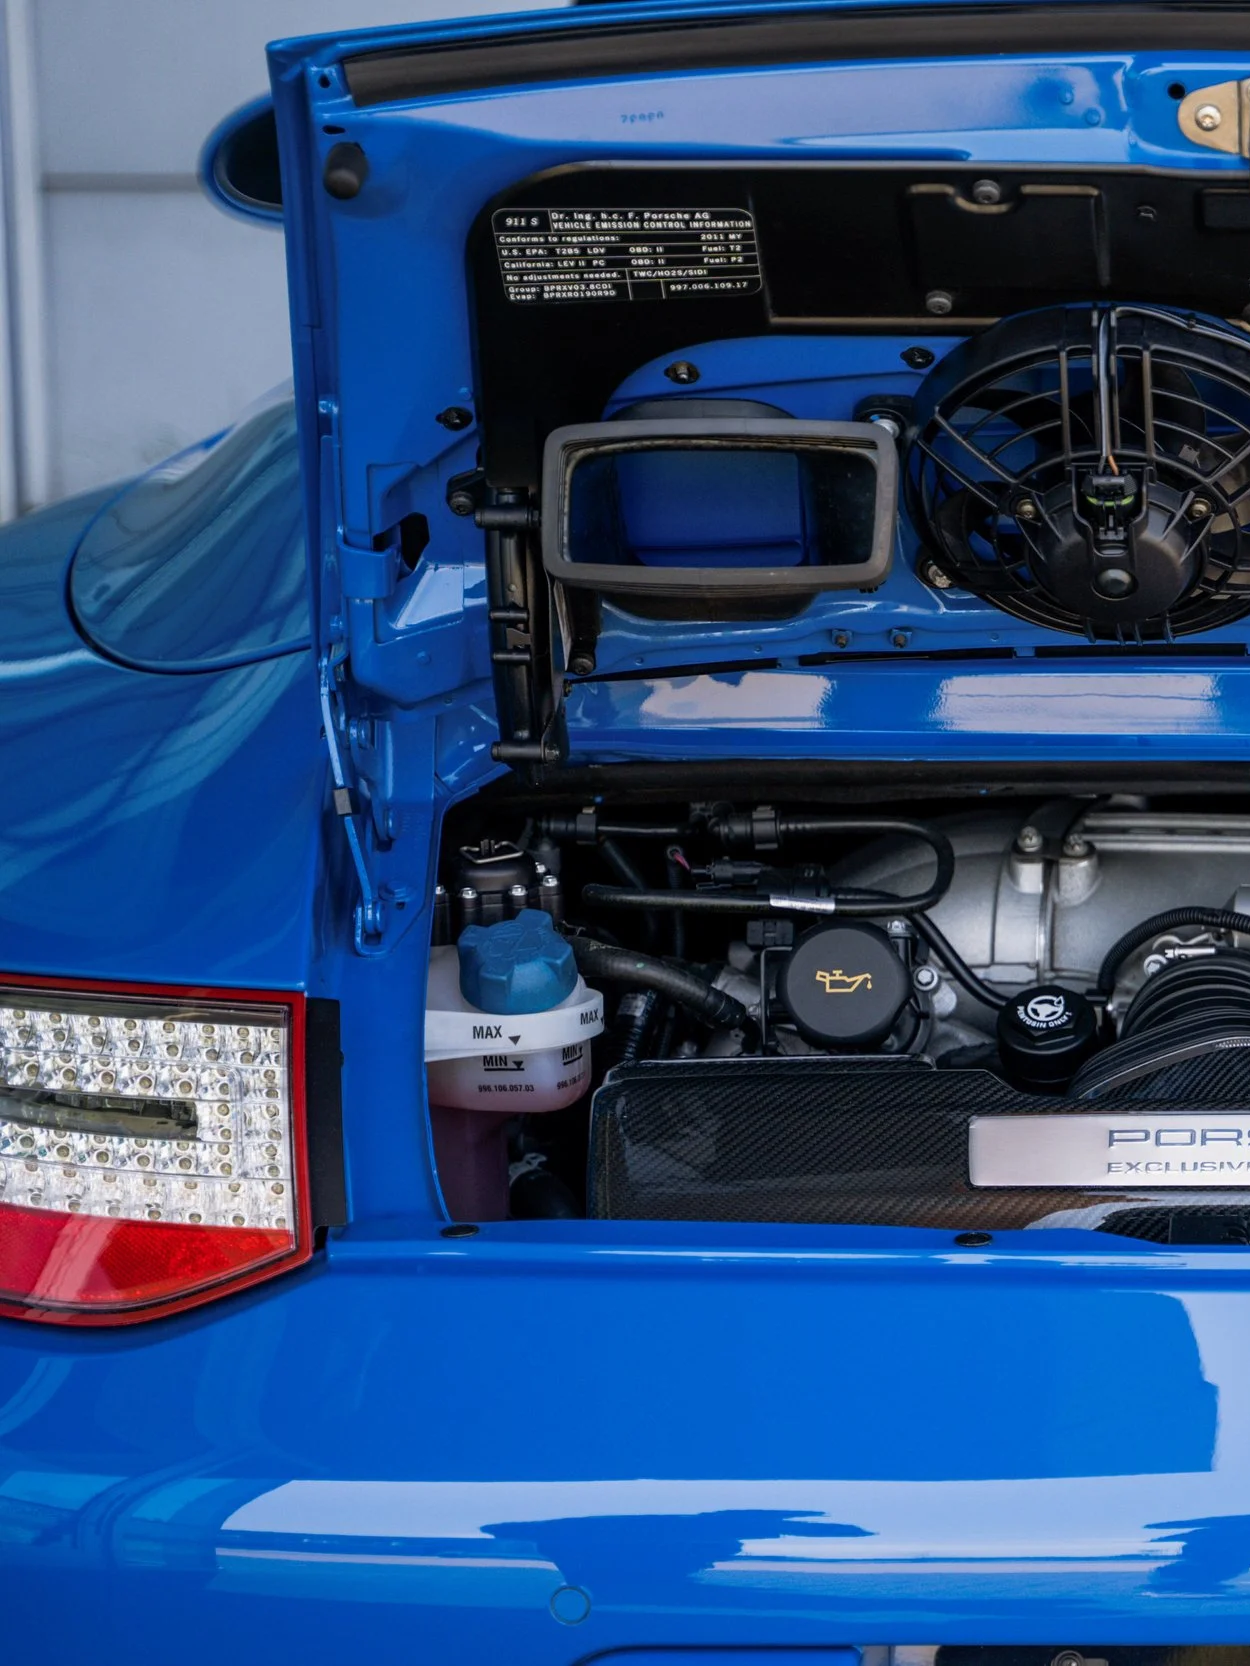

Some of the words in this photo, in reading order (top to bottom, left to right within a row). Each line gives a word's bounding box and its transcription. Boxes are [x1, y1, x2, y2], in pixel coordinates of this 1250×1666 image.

[551, 212, 569, 220] Dr.
[574, 212, 596, 221] Ing.
[600, 212, 623, 220] h.c.
[644, 212, 690, 220] Porsche
[505, 217, 525, 226] 911
[530, 217, 539, 226] S
[595, 221, 640, 229] EMISSION
[643, 221, 686, 229] CONTROL
[689, 220, 751, 228] INFORMATION
[561, 235, 620, 243] regulations:
[504, 260, 554, 268] California:
[523, 274, 580, 282] adjustments
[580, 1008, 599, 1025] MAX
[1017, 1006, 1047, 1028] PENTOSIN
[1048, 1015, 1069, 1027] ONLY
[473, 1025, 502, 1039] MAX
[562, 1044, 578, 1060] MIN
[483, 1055, 507, 1067] MIN
[477, 1084, 535, 1093] 996.106.057.03
